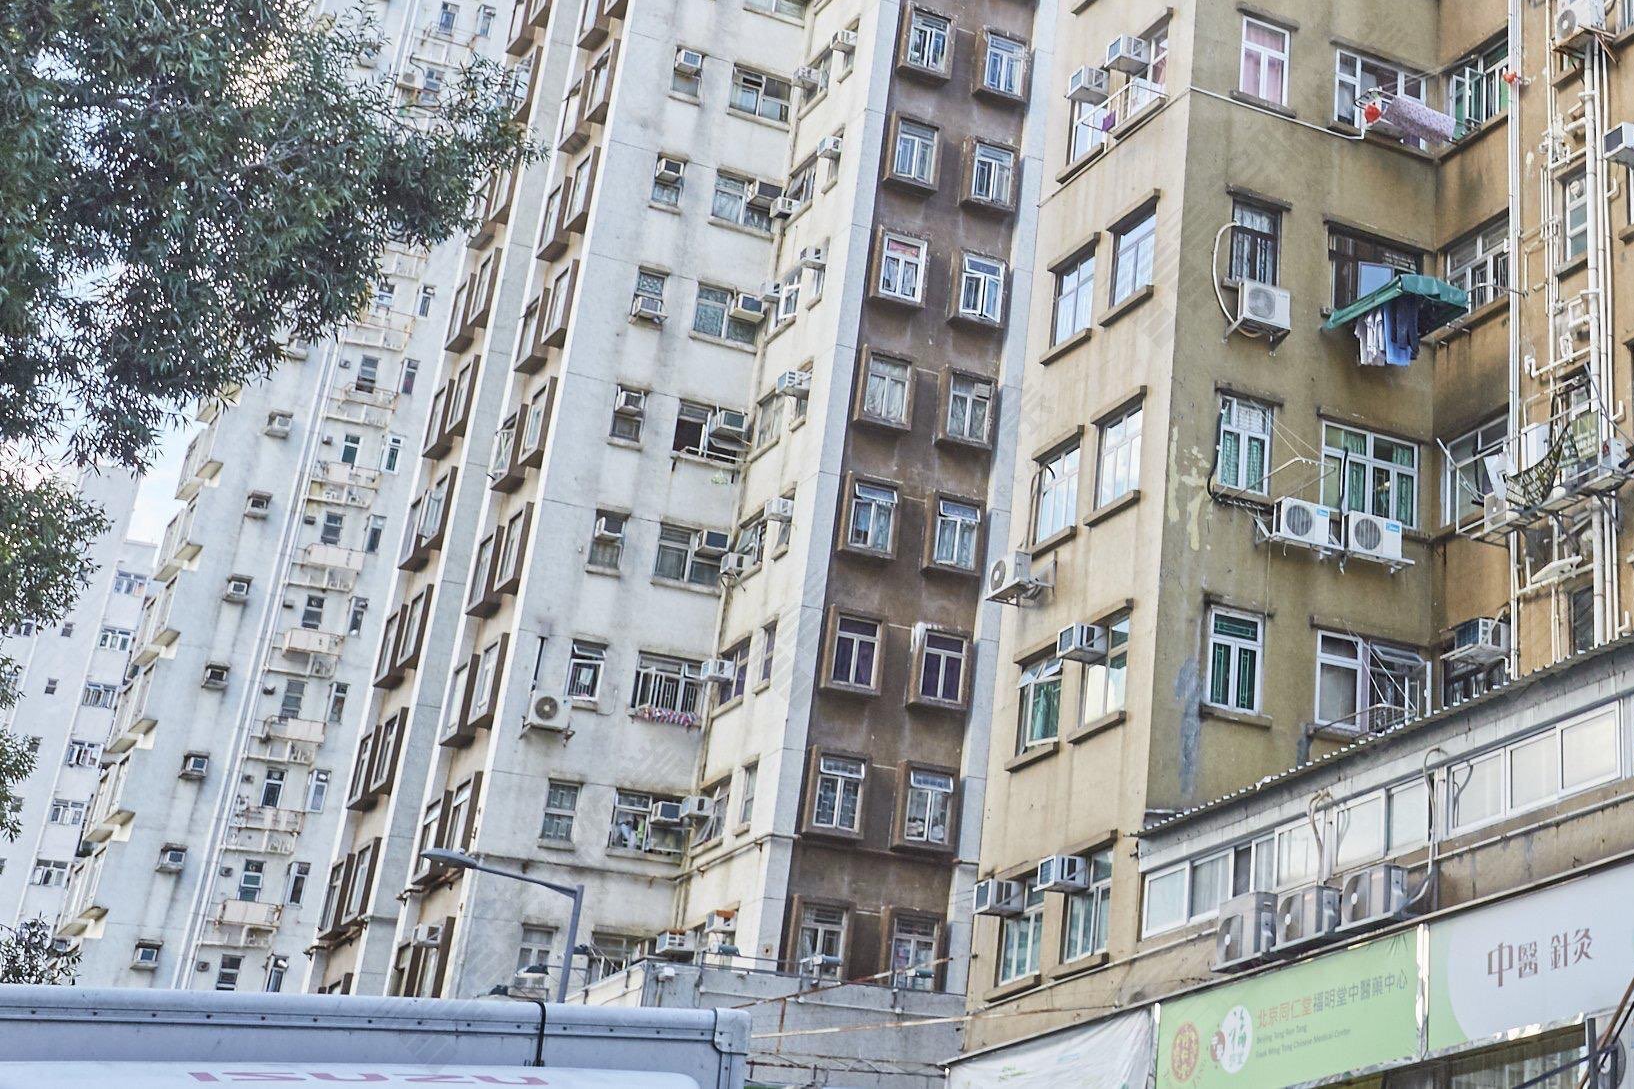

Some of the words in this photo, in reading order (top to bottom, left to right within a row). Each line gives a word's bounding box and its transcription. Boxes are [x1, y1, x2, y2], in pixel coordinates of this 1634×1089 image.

[1487, 941, 1538, 988] 中醫
[1550, 927, 1593, 971] 針灸
[188, 1072, 550, 1085] ISUZU
